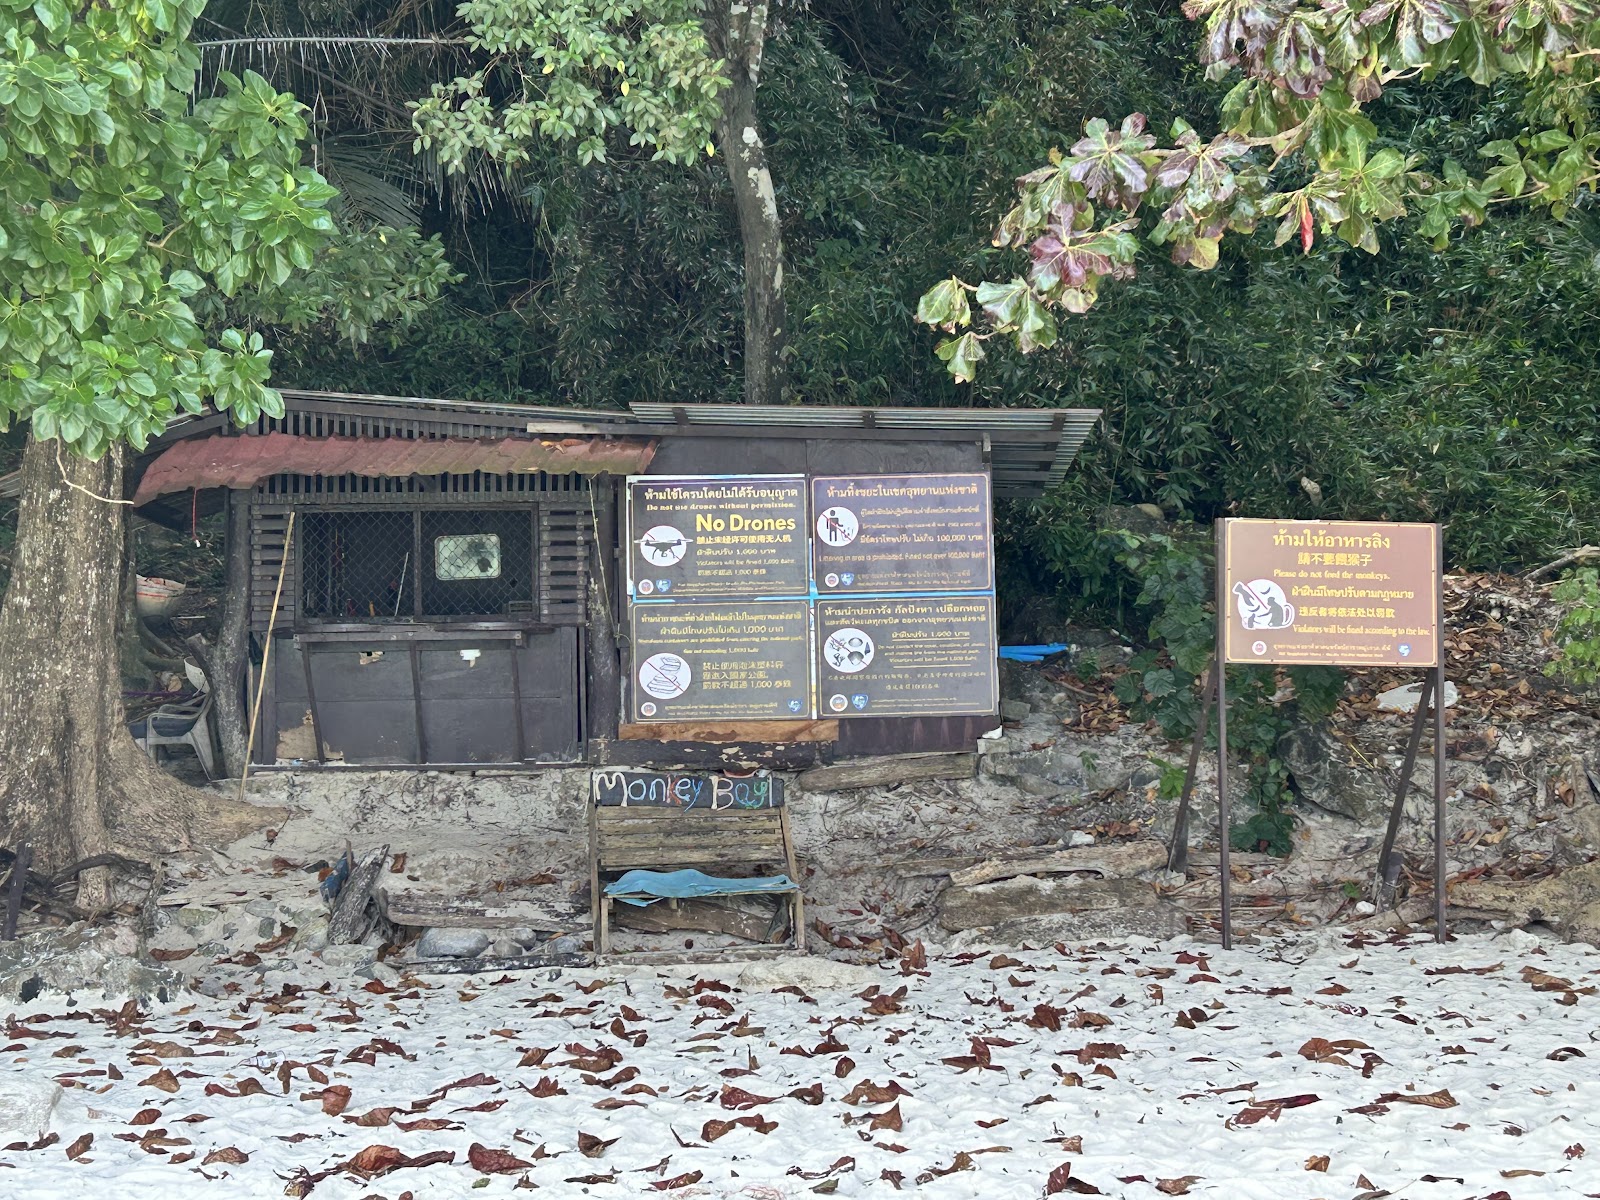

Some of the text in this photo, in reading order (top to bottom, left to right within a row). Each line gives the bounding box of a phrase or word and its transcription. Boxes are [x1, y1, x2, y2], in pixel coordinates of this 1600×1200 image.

[751, 501, 796, 510] permission.
[696, 513, 796, 532] No Drones
[937, 534, 965, 542] 100,000
[1273, 528, 1390, 549] ห้ามให้อาหารลิง
[1274, 568, 1391, 581] Please do not feed the monkeys.
[1293, 623, 1323, 634] Violators
[1324, 624, 1337, 633] will
[1338, 625, 1346, 633] be
[1346, 625, 1364, 634] fined
[1365, 625, 1397, 637] according
[1398, 627, 1405, 635] to
[1406, 627, 1417, 636] the
[750, 681, 772, 689] 1,000
[595, 772, 704, 812] Monkey
